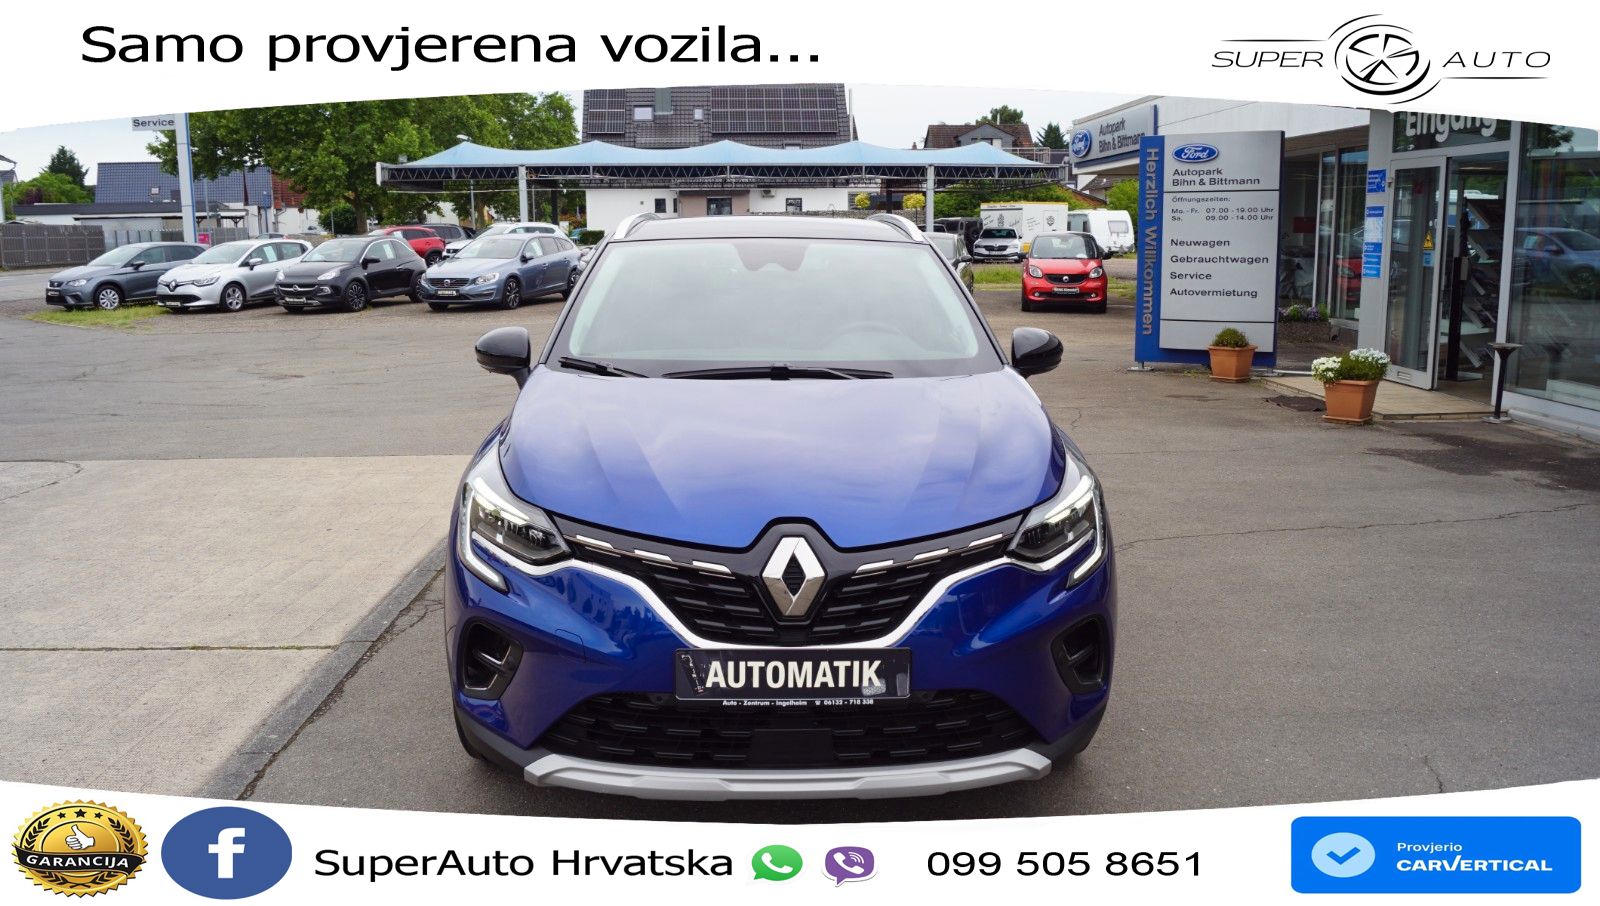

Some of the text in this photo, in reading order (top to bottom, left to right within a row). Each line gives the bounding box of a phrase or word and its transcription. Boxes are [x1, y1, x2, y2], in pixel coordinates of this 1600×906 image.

[133, 119, 175, 127] Service
[1099, 117, 1126, 137] Autopark
[1181, 146, 1209, 159] Ford
[1173, 168, 1223, 177] Autopark
[1172, 177, 1260, 187] Bihn & Bittmann
[1142, 148, 1160, 335] Herzlich Willkommen
[1170, 239, 1231, 248] Neuwagen
[1170, 255, 1269, 265] Gebrauchtwagen
[1170, 271, 1212, 280] Service
[1169, 288, 1258, 299] Autovermietung
[705, 660, 882, 689] AUTOMATIK
